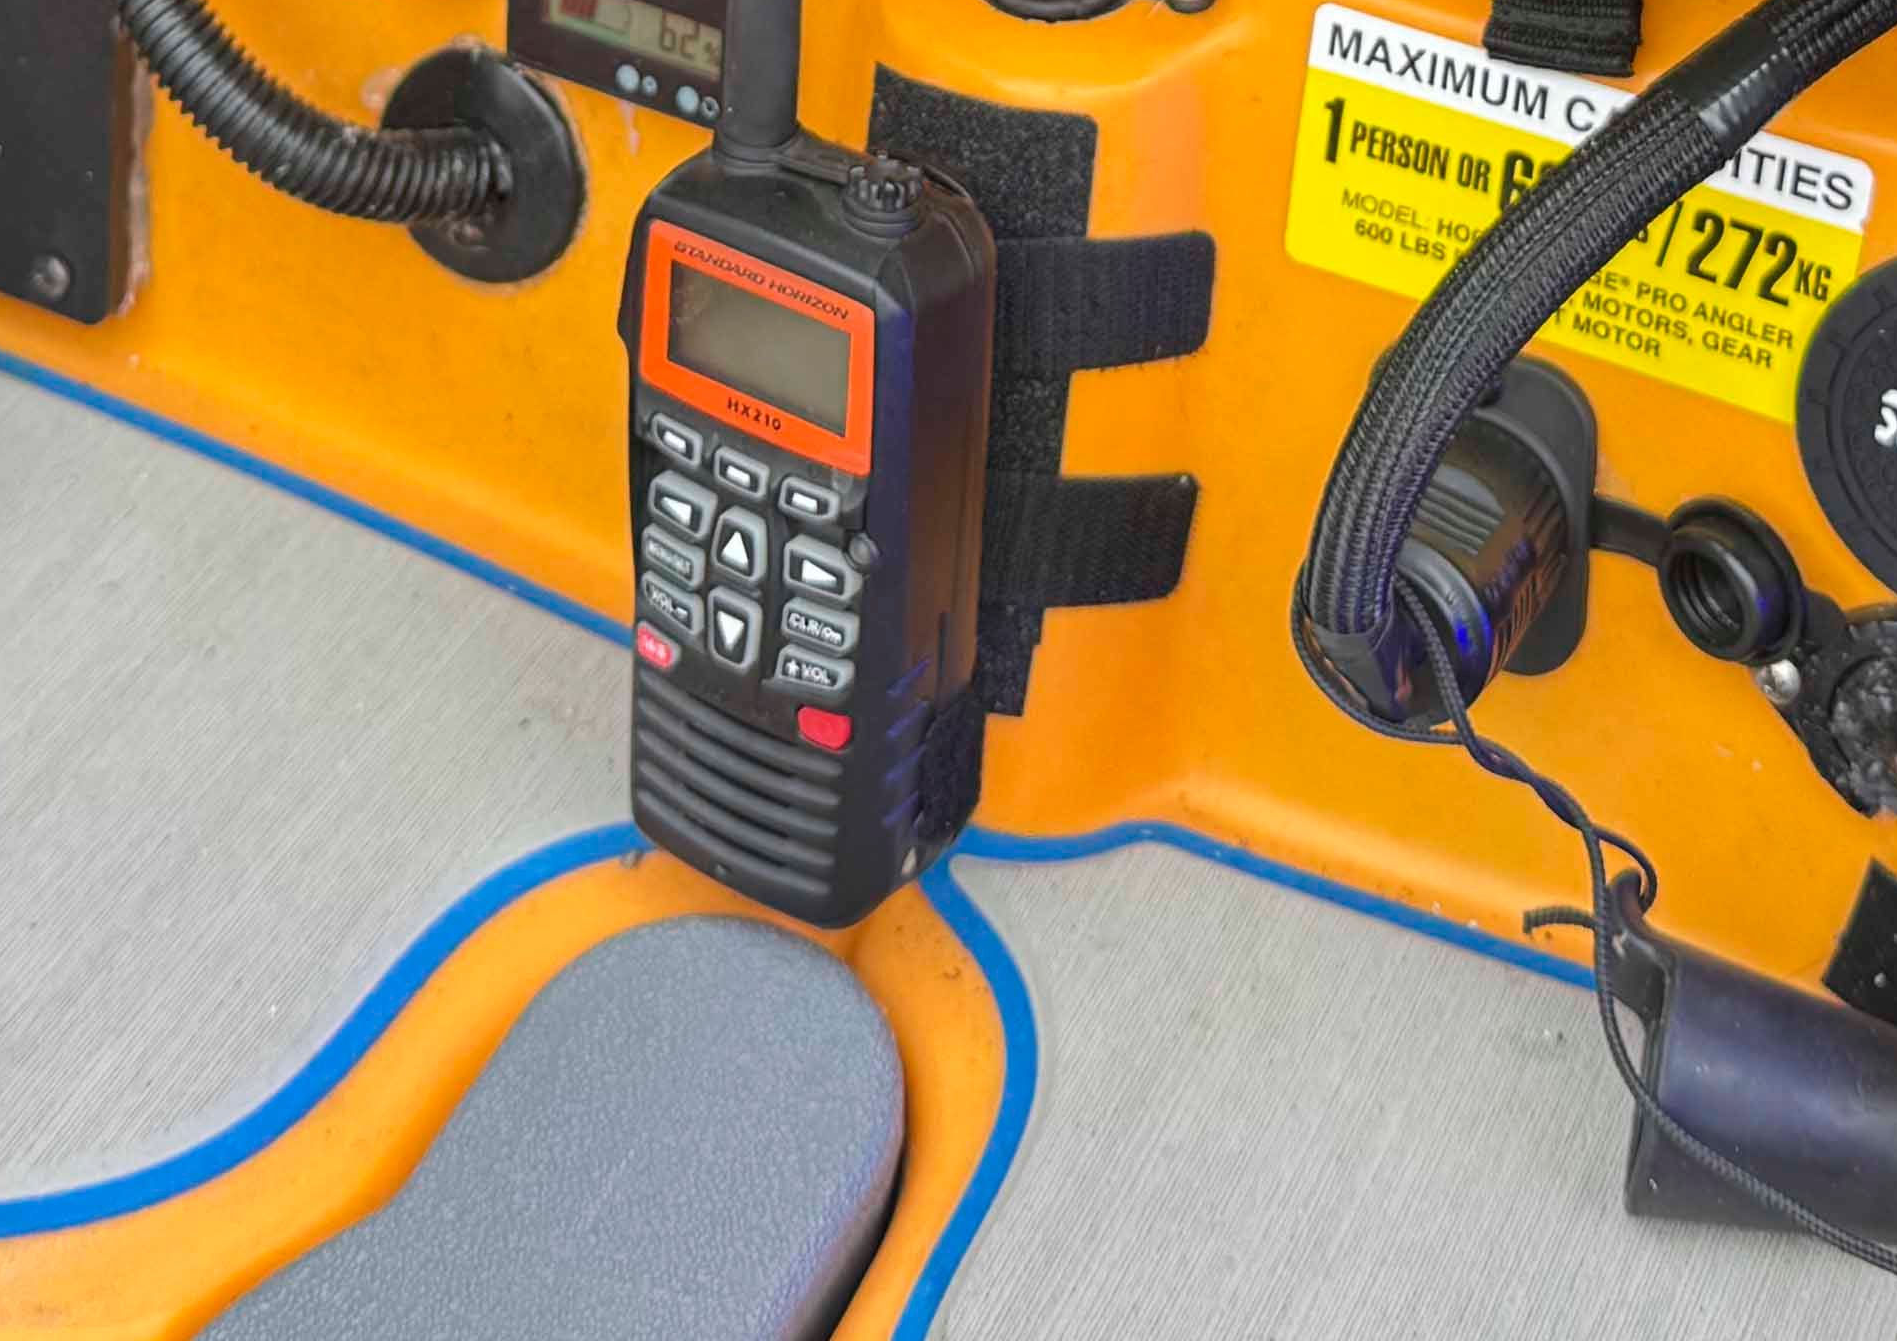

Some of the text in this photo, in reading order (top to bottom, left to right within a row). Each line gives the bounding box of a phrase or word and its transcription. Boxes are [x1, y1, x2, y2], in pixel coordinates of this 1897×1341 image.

[1328, 23, 1549, 120] MAXIMUM
[1324, 97, 1345, 164] 1
[1350, 120, 1449, 180] PERSON
[1457, 153, 1491, 192] OR
[674, 241, 849, 320] STANDARD HORIZON
[1342, 188, 1794, 350] MODEL: PRO ANGLER
[1354, 218, 1393, 245] 600
[1400, 232, 1446, 261] LBS
[1582, 290, 1693, 345] MOTORS,
[1701, 330, 1774, 368] GEAR
[1572, 313, 1661, 357] MOTOR
[727, 396, 783, 432] HX210
